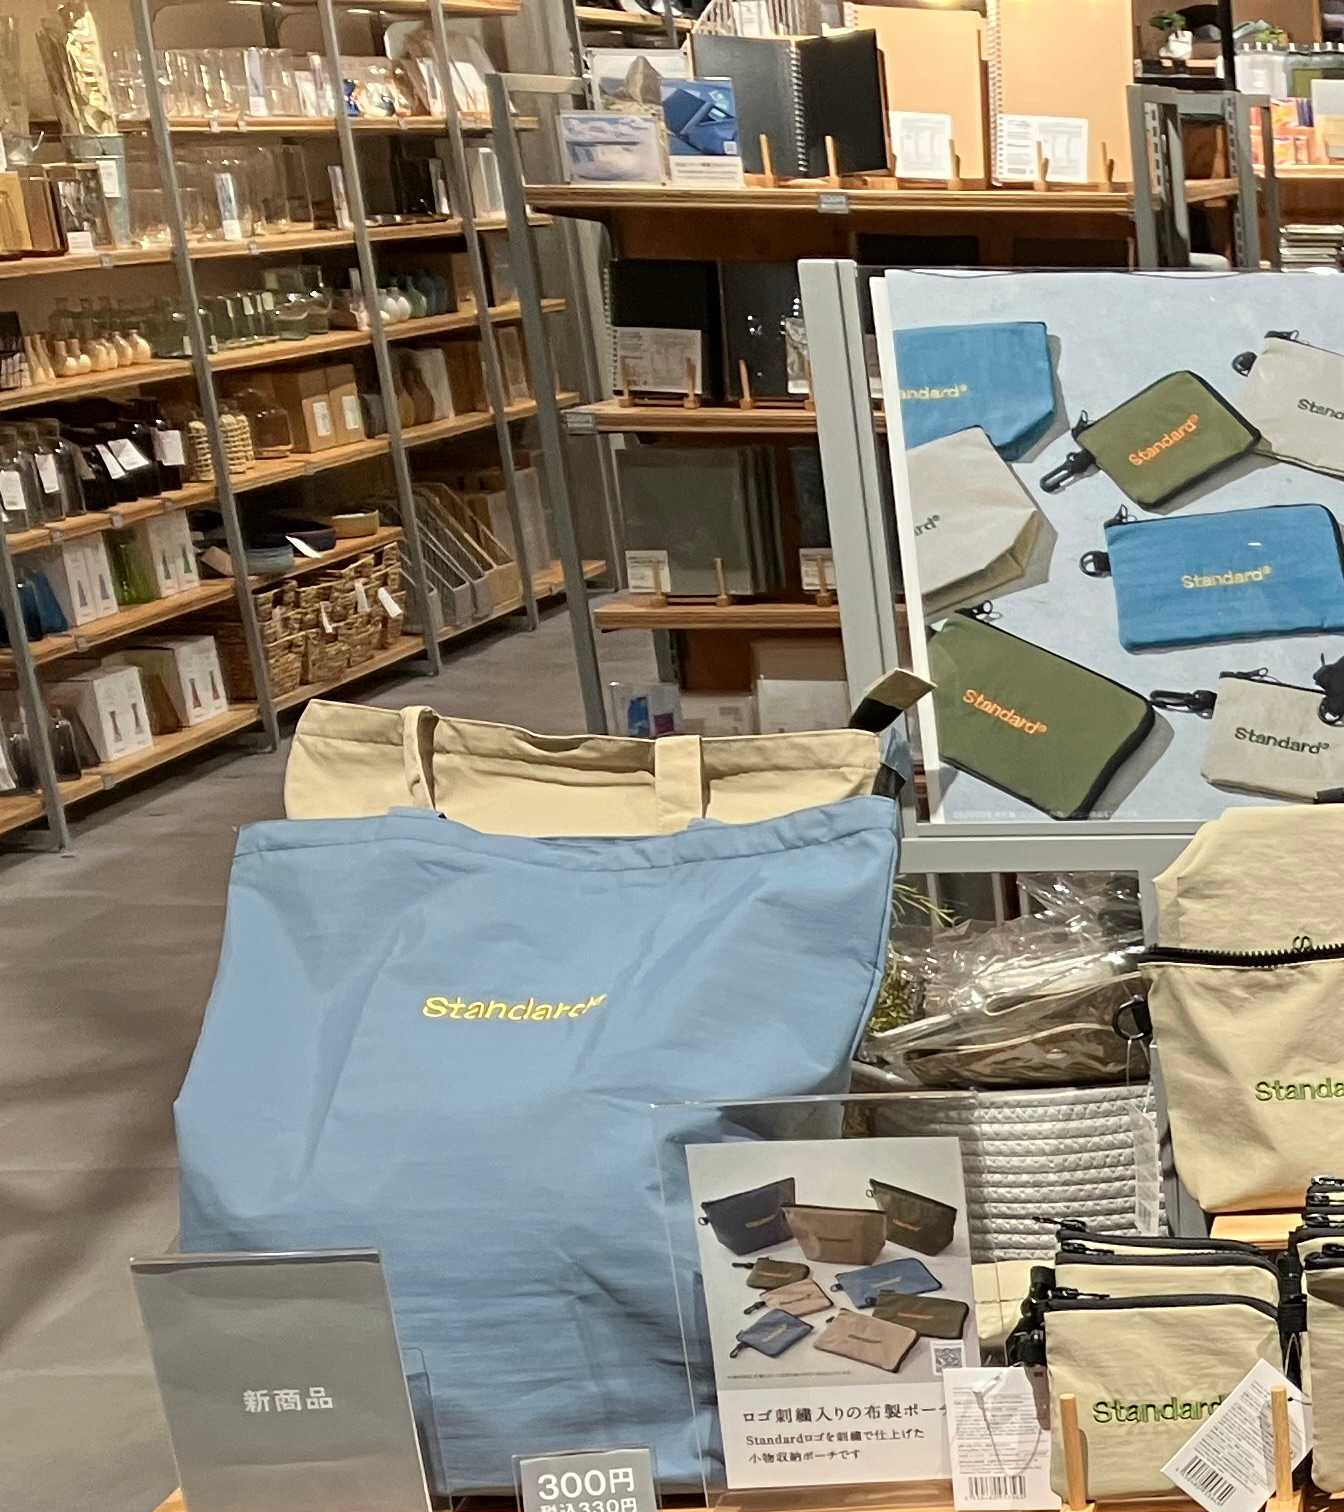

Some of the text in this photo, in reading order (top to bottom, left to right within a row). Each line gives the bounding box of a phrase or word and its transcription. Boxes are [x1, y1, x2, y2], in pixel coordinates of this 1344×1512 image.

[243, 1386, 334, 1413] 新商品
[538, 1467, 635, 1501] 300円
